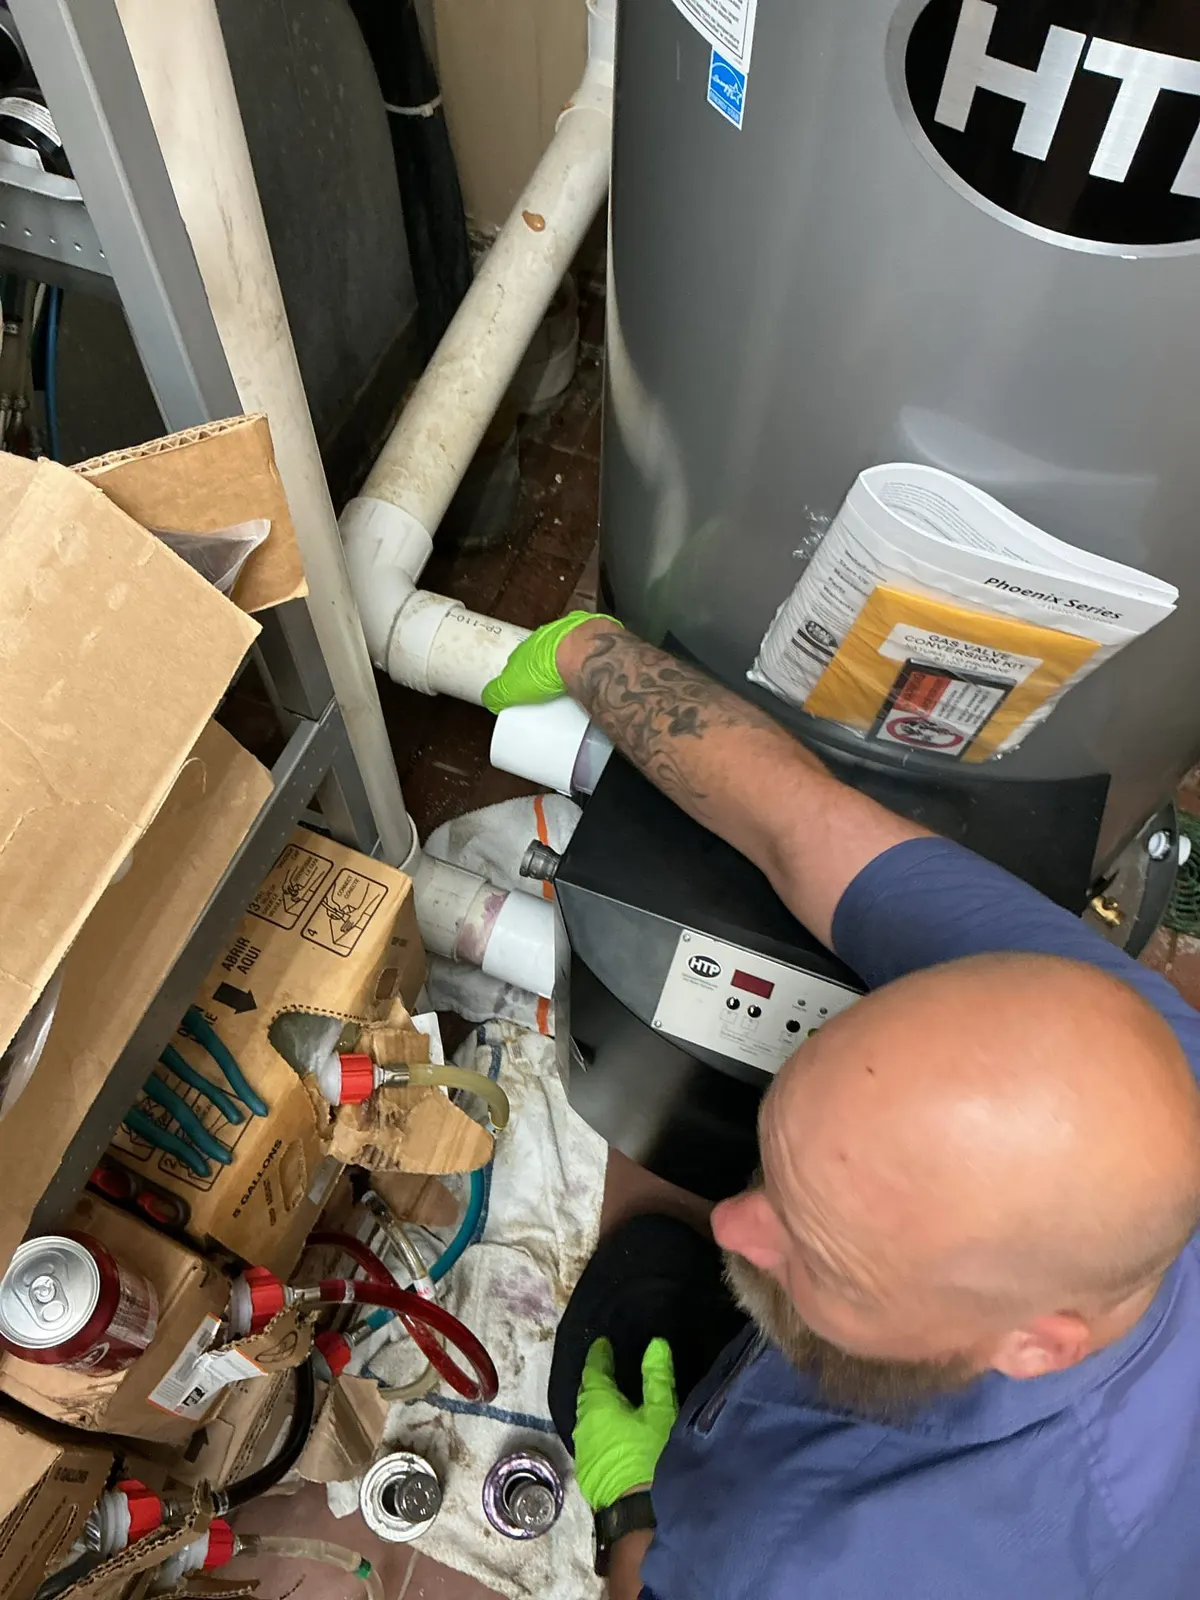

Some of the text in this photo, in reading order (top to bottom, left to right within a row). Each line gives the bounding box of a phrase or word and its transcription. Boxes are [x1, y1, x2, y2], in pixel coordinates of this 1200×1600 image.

[934, 0, 1200, 199] HT
[984, 576, 1063, 604] Phoenix
[1063, 598, 1123, 620] Series
[905, 635, 999, 664] CONVERSION
[1003, 661, 1025, 670] KIT
[929, 635, 1009, 660] GAS VALVE
[307, 928, 318, 937] 4
[221, 936, 251, 972] ABRIR
[236, 946, 262, 975] AQUI
[690, 957, 719, 976] HTP
[241, 1139, 282, 1205] GALLONS
